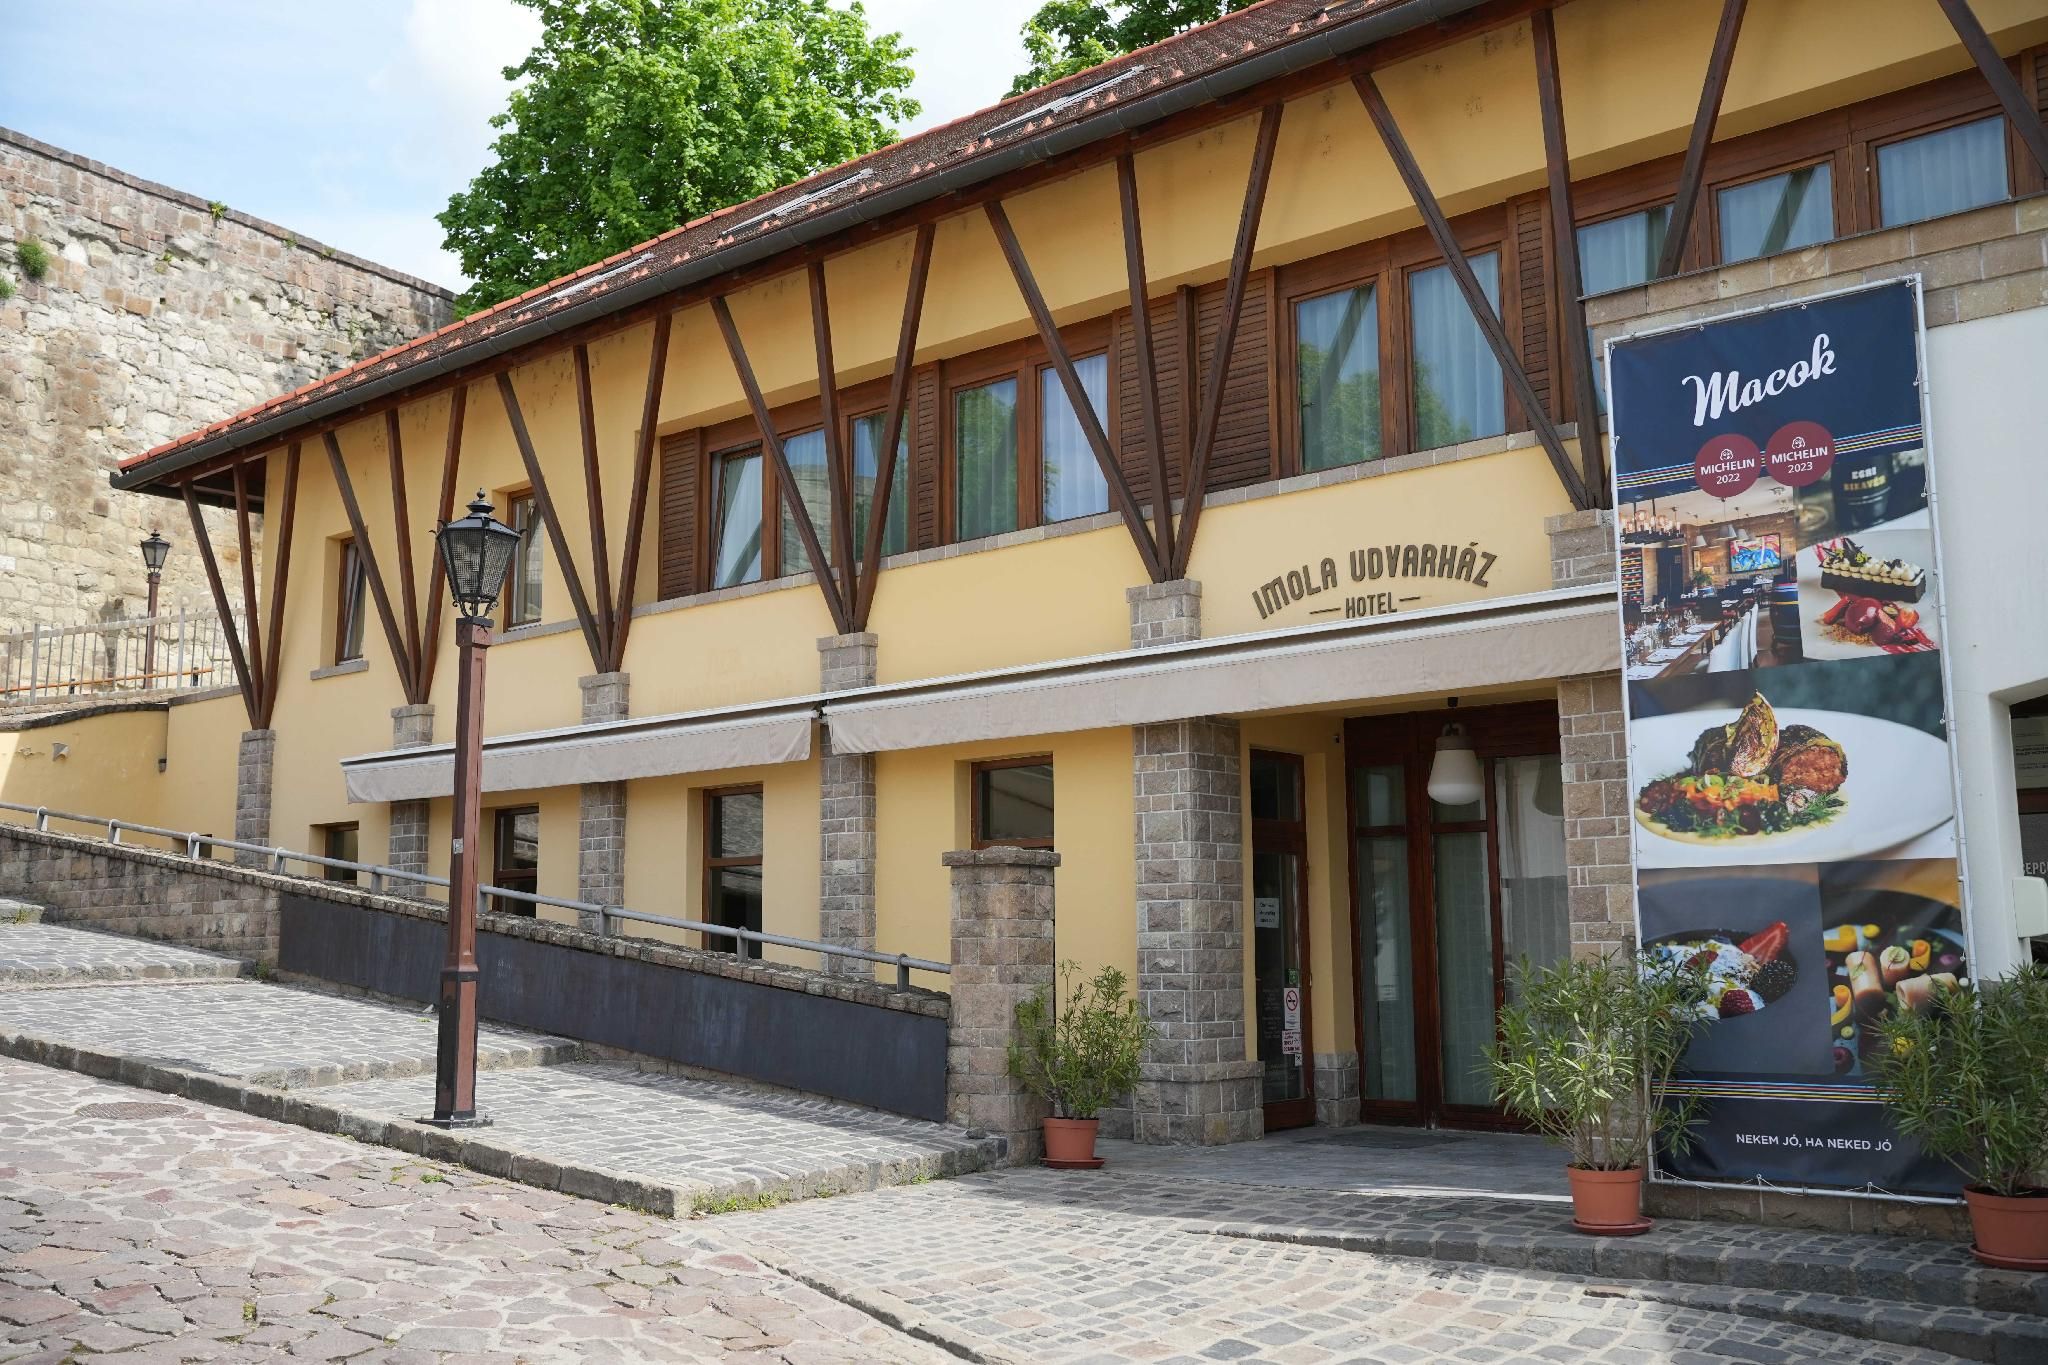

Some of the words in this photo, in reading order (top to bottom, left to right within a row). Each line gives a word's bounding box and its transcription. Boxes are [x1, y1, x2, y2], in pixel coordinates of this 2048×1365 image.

[1682, 333, 1837, 427] Macok
[1771, 446, 1828, 464] MICHELIN
[1700, 458, 1755, 476] MICHELIN
[1788, 461, 1813, 474] 2023
[1716, 473, 1740, 485] 2022
[1252, 557, 1338, 620] IMOLA
[1350, 541, 1498, 588] UDVARHÁZ
[1345, 592, 1398, 619] HOTEL
[1735, 1133, 1779, 1146] NEKEM
[1783, 1133, 1802, 1148] JÓ,
[1805, 1137, 1824, 1148] HA
[1827, 1138, 1872, 1151] NEKED
[1875, 1138, 1893, 1152] JÓ
